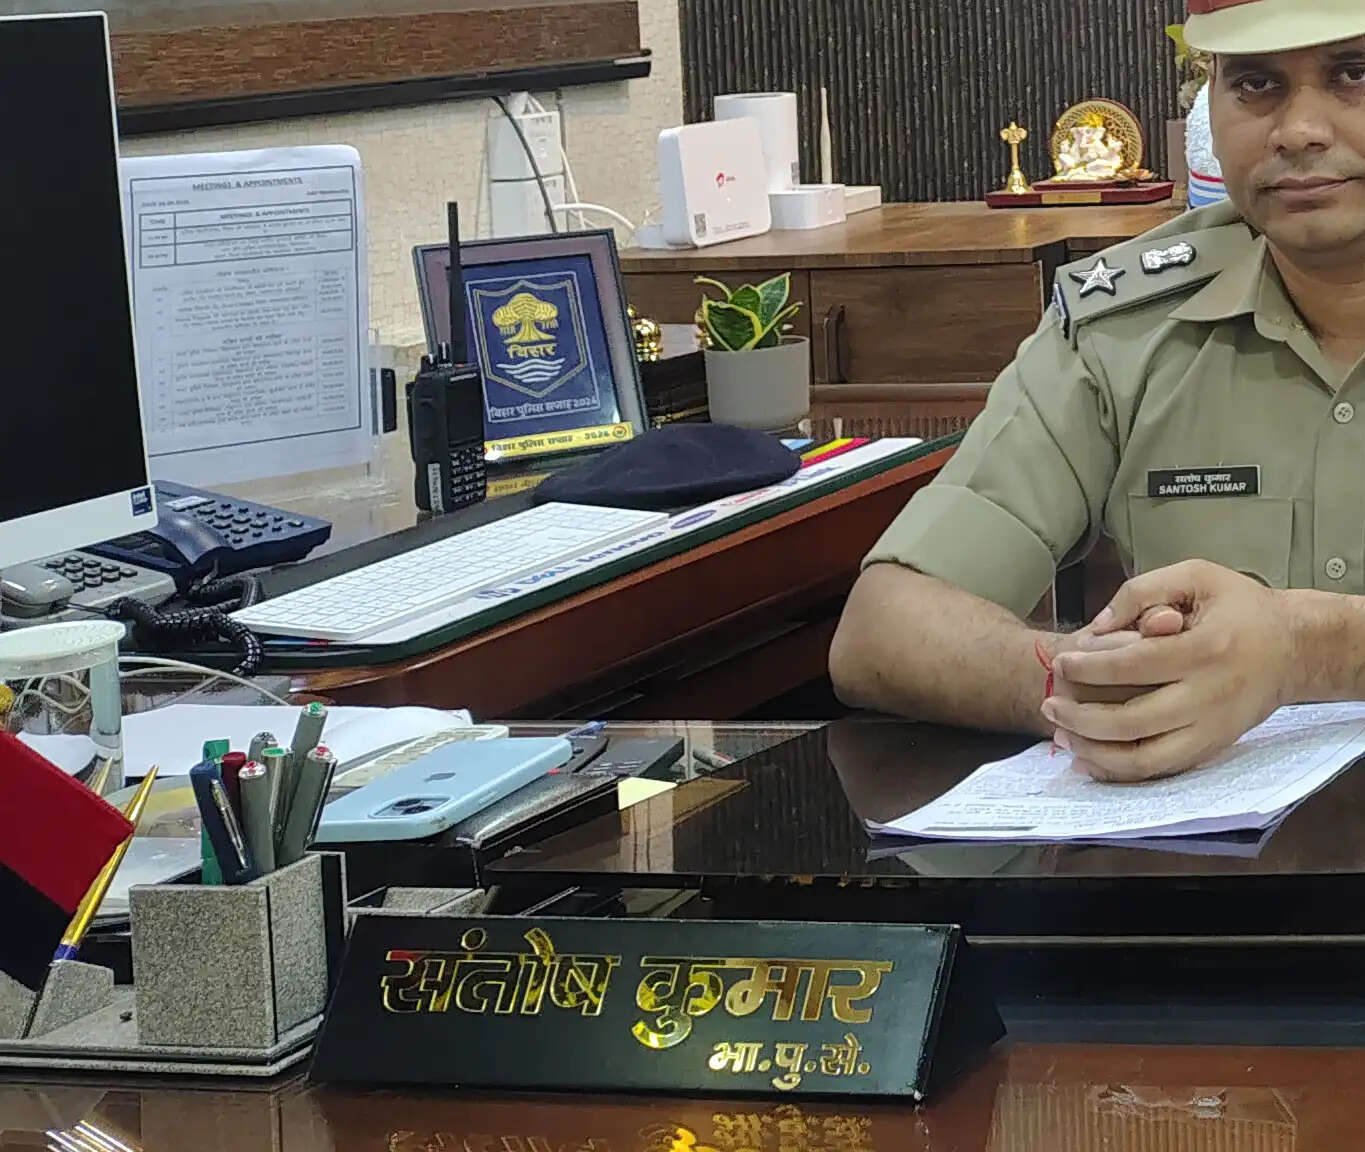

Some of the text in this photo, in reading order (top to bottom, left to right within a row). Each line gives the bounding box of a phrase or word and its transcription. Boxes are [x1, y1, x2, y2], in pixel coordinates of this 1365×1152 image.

[1159, 482, 1247, 495] SANTOSH KUMAR
[380, 928, 894, 1050] संतोष कुमार
[708, 1033, 872, 1091] भा.पु.से.
